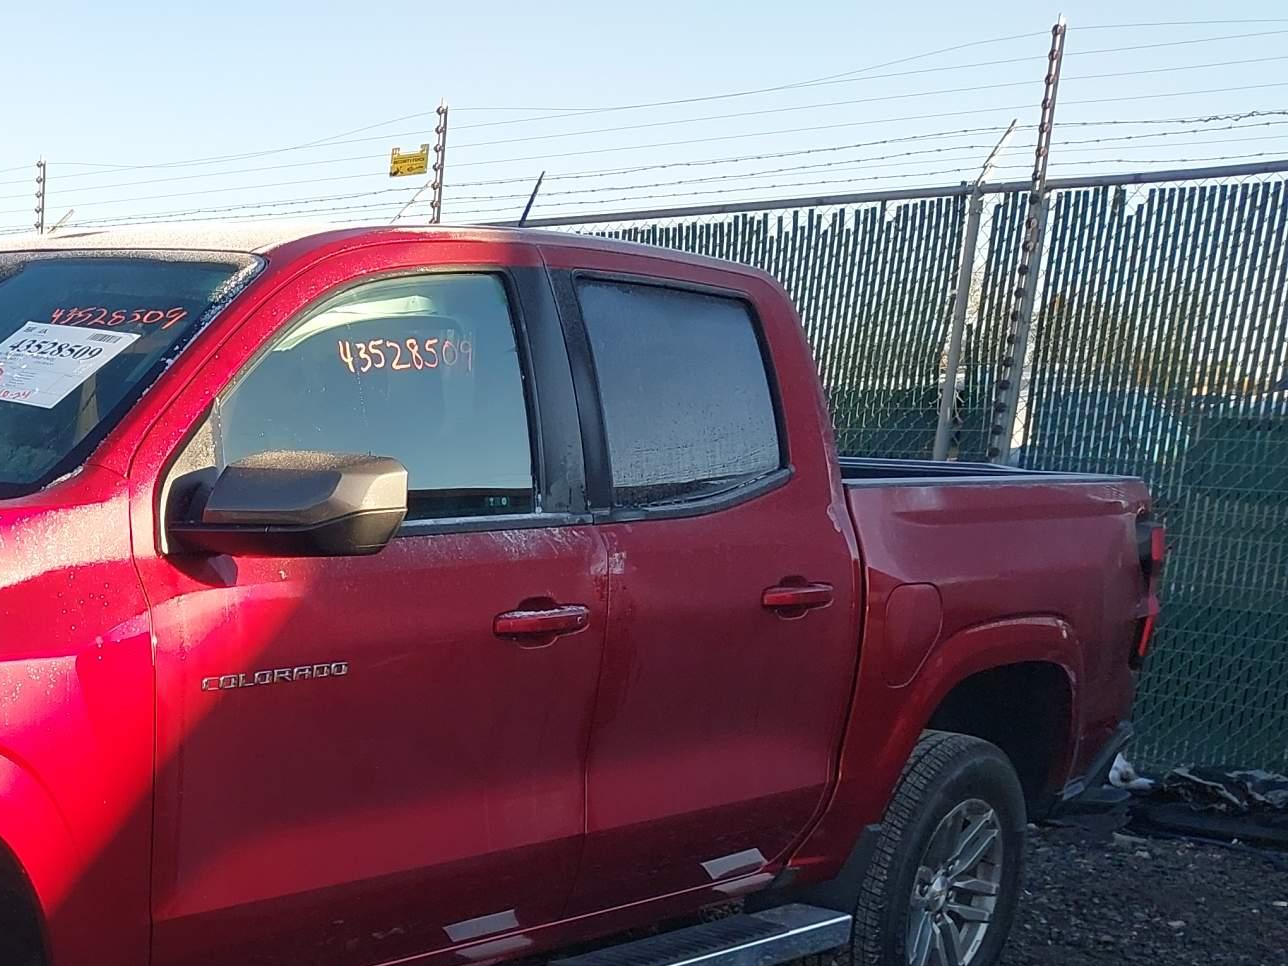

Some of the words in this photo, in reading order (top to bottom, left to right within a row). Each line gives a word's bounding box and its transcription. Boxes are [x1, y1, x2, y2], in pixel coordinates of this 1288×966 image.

[9, 338, 104, 361] 43528509
[338, 338, 473, 373] 43528509
[200, 661, 349, 692] COLORADO
